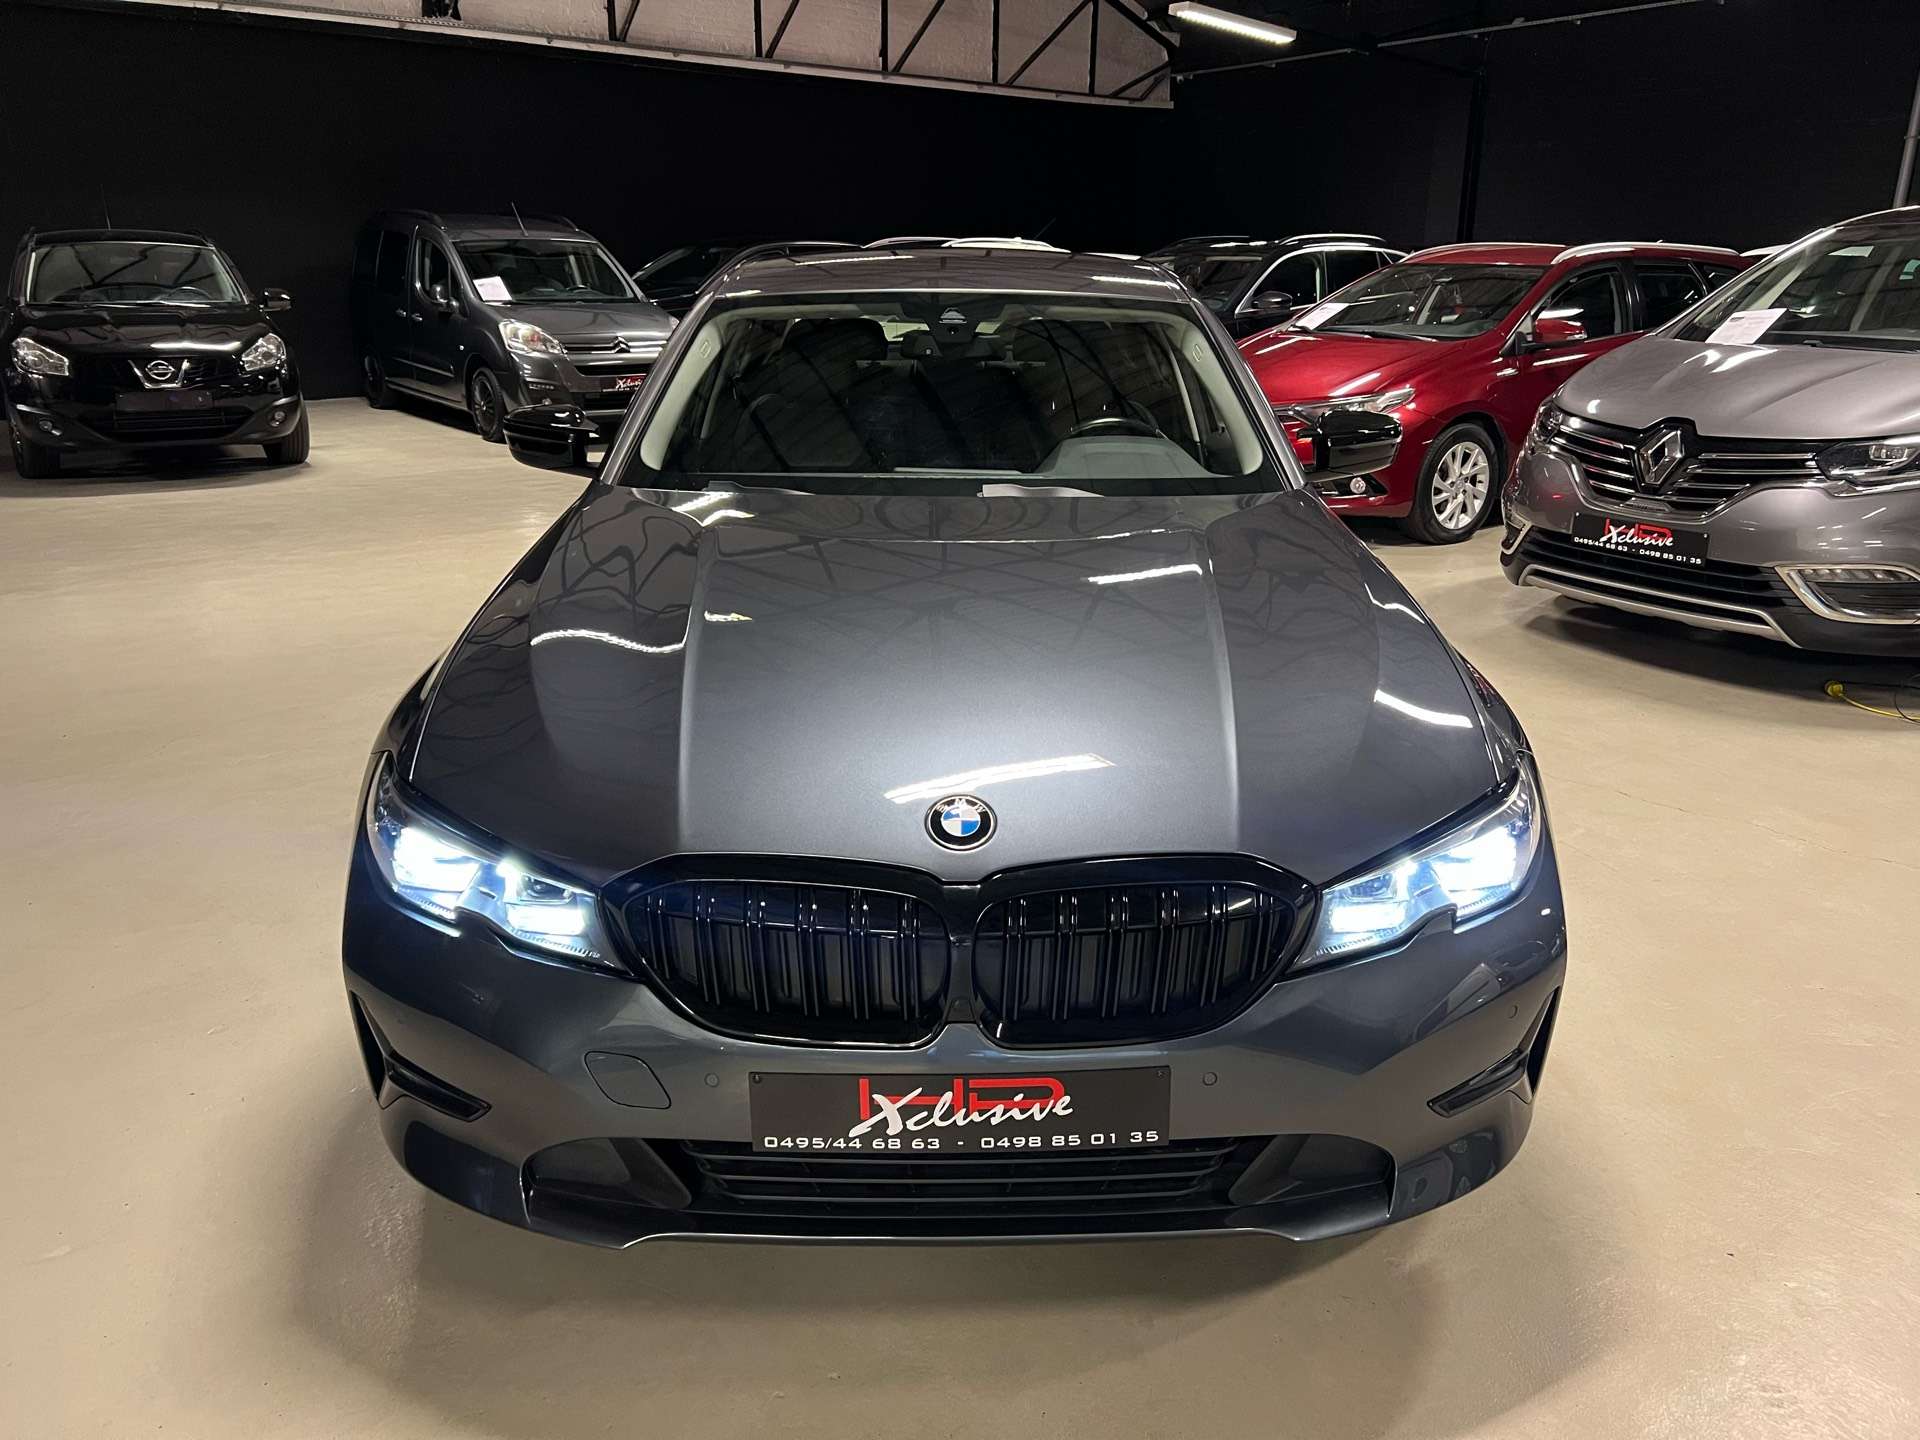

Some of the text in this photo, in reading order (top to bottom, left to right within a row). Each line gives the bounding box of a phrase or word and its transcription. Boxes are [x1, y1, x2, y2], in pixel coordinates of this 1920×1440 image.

[1574, 536, 1604, 547] 0495/44
[1617, 544, 1628, 552] 63
[1639, 549, 1660, 558] 0498
[1599, 525, 1674, 547] Xclusive
[936, 797, 986, 813] BMW
[848, 1087, 1073, 1137] Xclusive
[763, 1137, 863, 1150] 0495/44
[872, 1137, 902, 1150] 68
[910, 1137, 941, 1149] 63
[980, 1135, 1043, 1149] 0498
[1051, 1134, 1081, 1147] 85
[1090, 1132, 1118, 1145] 01
[1129, 1130, 1160, 1143] 35
